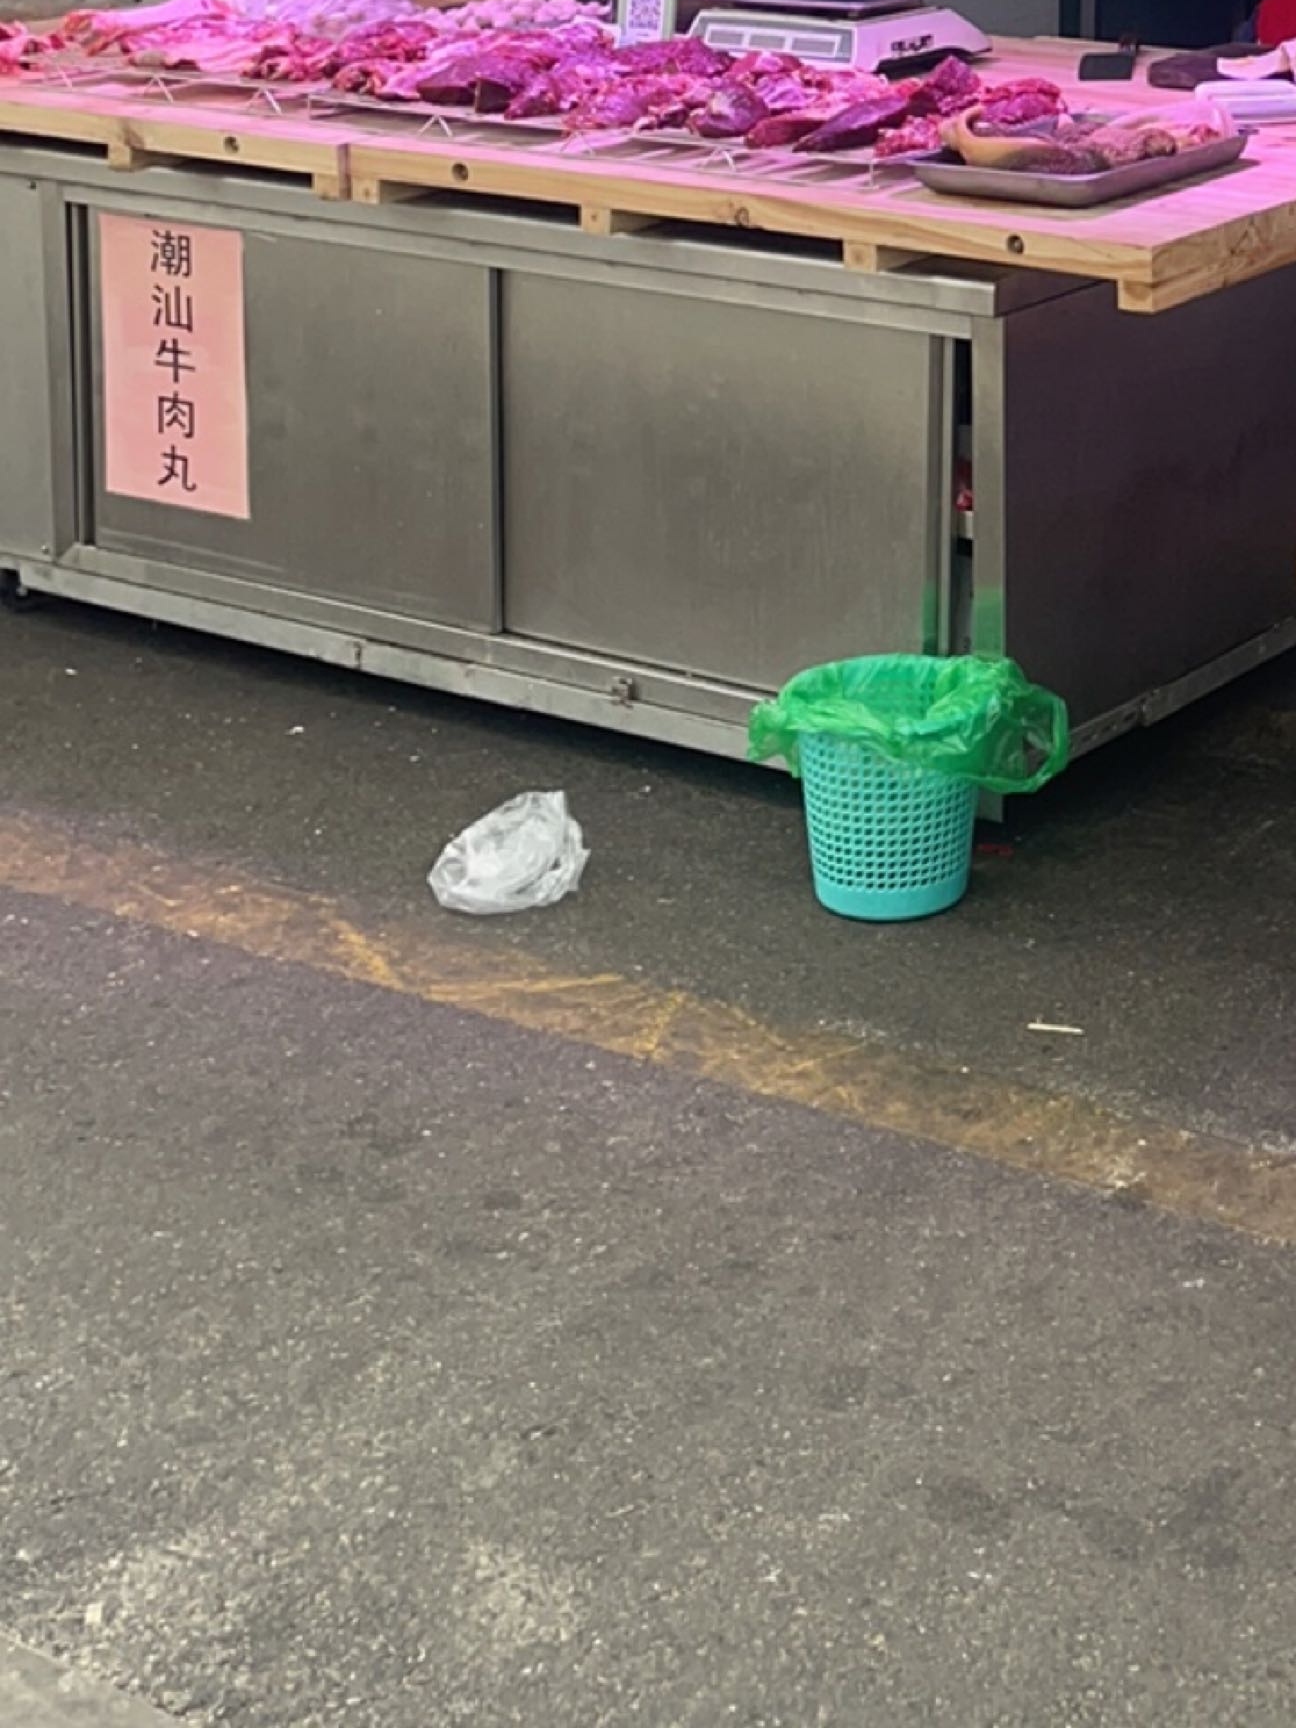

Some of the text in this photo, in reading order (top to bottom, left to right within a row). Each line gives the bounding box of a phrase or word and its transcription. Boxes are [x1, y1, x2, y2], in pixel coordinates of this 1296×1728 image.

[150, 229, 197, 492] 潮汕牛肉丸
